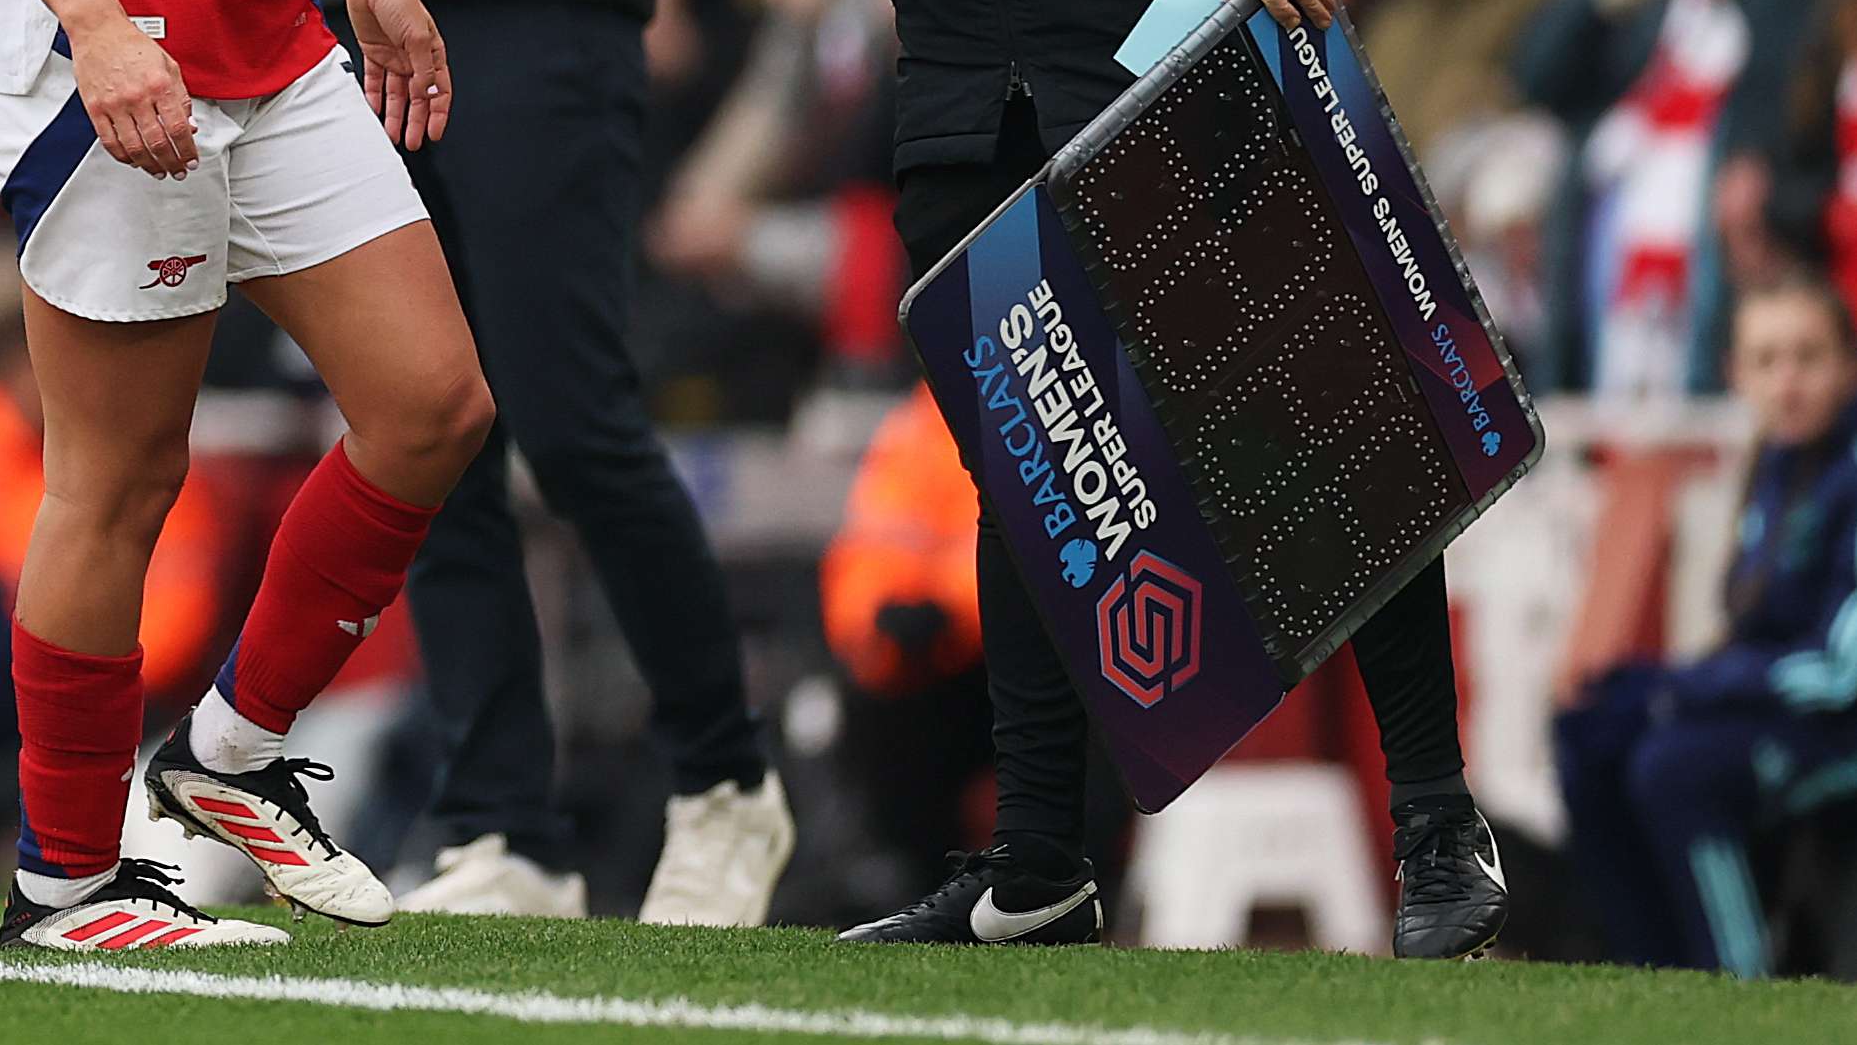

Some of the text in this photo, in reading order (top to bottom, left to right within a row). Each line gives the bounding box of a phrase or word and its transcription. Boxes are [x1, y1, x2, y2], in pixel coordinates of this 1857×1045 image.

[1286, 26, 1491, 432] BARCLAYS WOMEN'S SUPER LEAGU
[963, 334, 1076, 540] BARCLAYS
[999, 303, 1133, 562] WOMEN'S
[1027, 278, 1157, 530] SUPER LEAGUE
